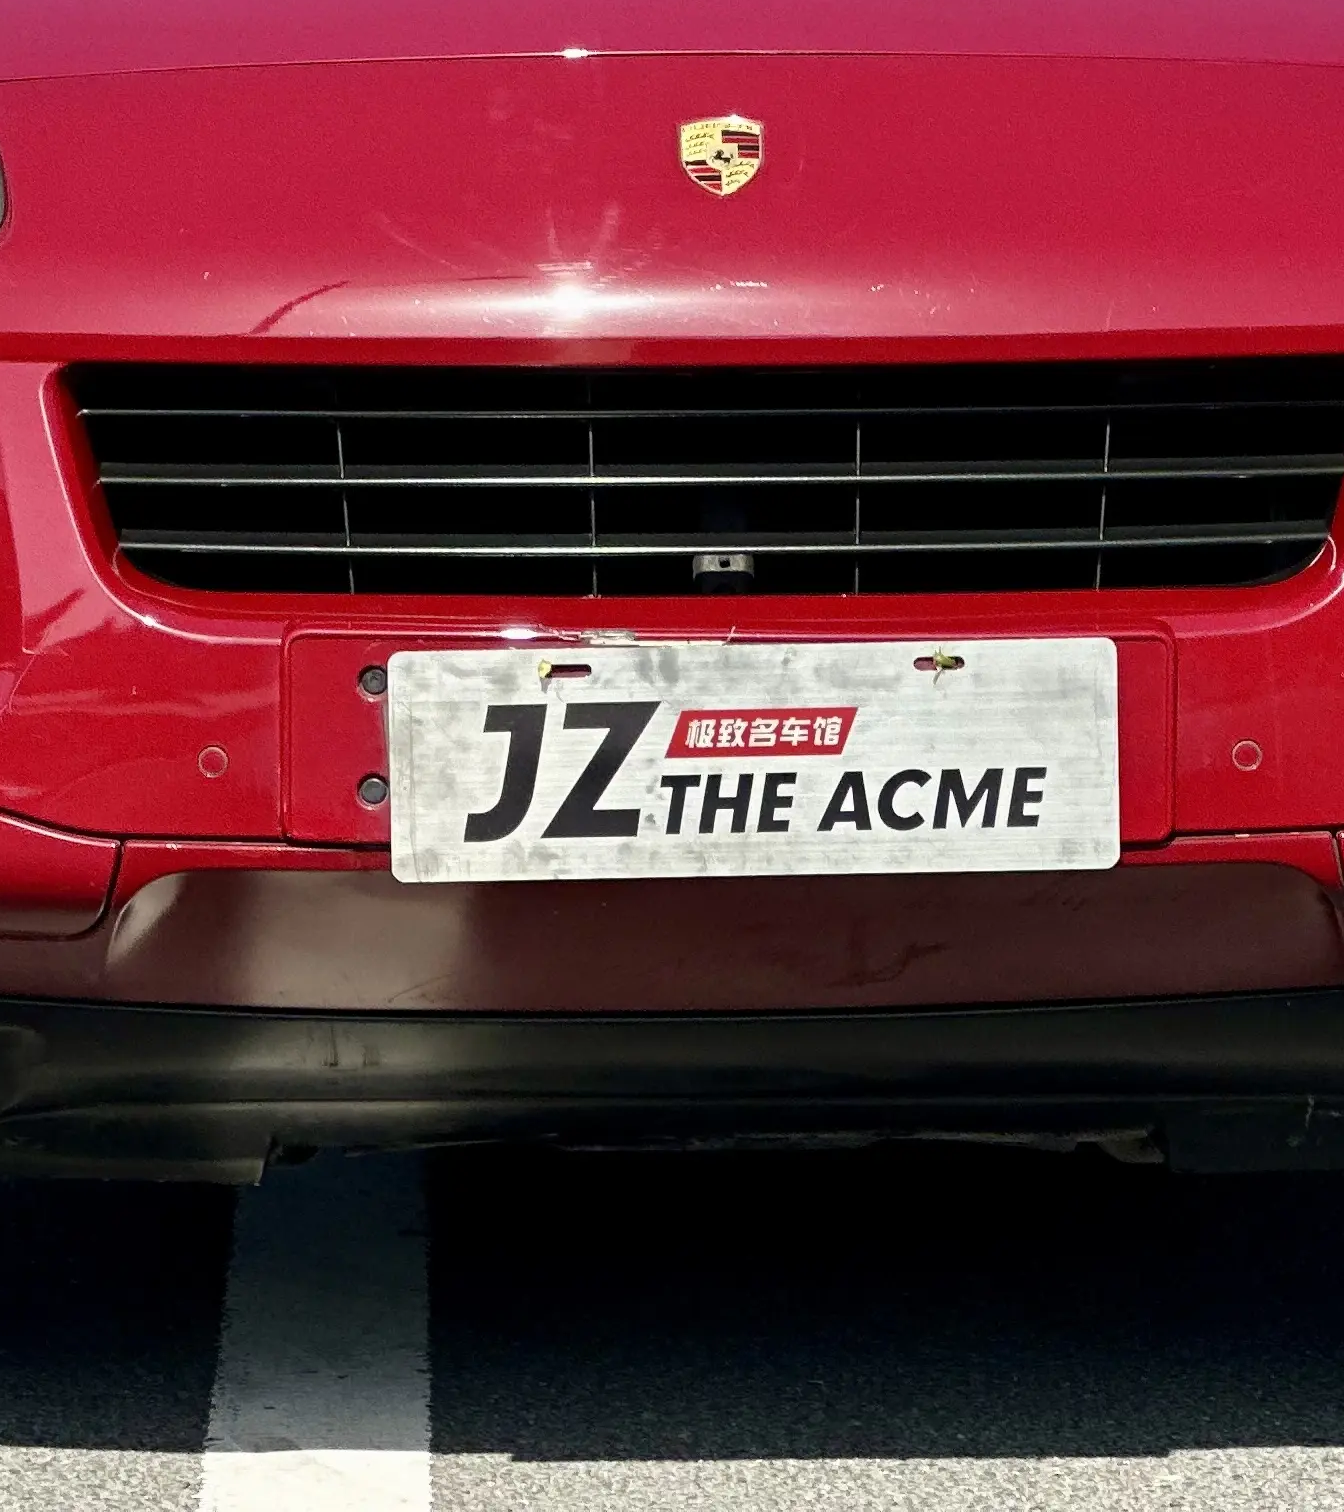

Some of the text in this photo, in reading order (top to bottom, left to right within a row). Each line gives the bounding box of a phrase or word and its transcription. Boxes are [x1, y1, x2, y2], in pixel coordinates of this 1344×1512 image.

[685, 716, 842, 749] 极致名车馆
[464, 701, 661, 842] JZ
[660, 767, 1047, 835] THE ACME
